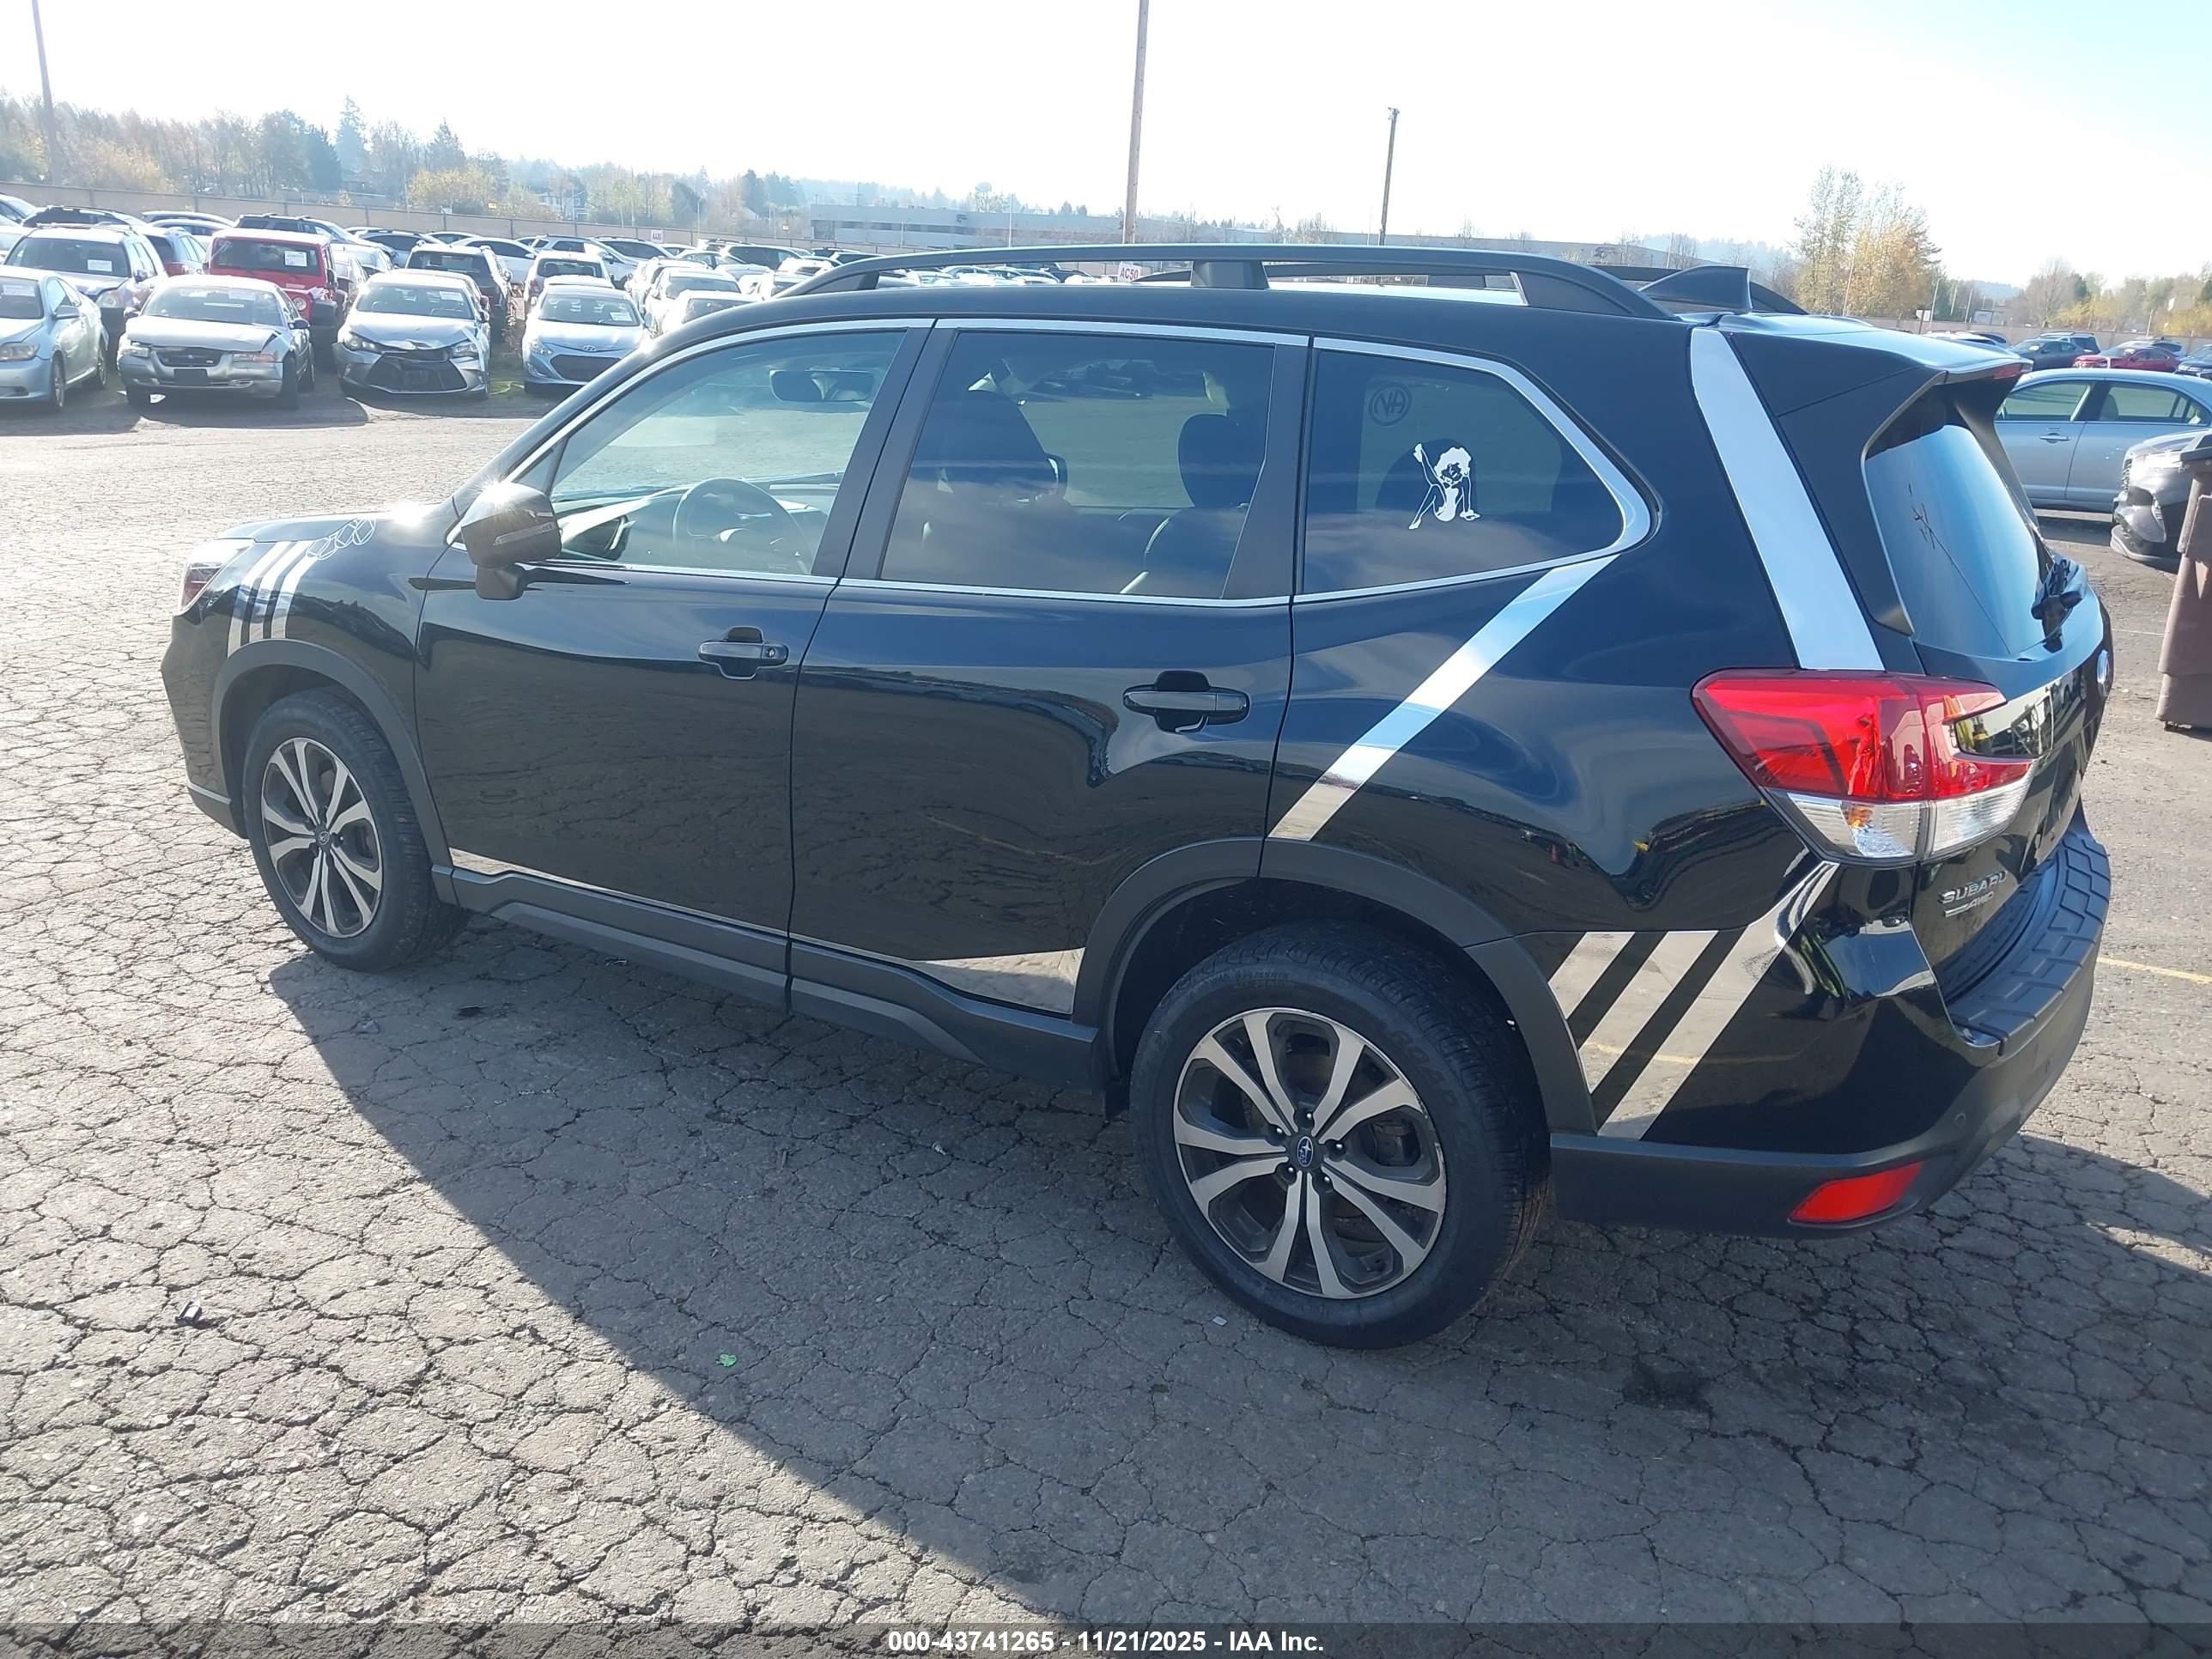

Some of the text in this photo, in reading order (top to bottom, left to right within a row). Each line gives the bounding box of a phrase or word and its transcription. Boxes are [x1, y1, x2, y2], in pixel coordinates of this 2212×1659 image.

[1120, 267, 1139, 281] AC50
[1938, 869, 2008, 904] SUBARU
[1965, 890, 1994, 910] AWD
